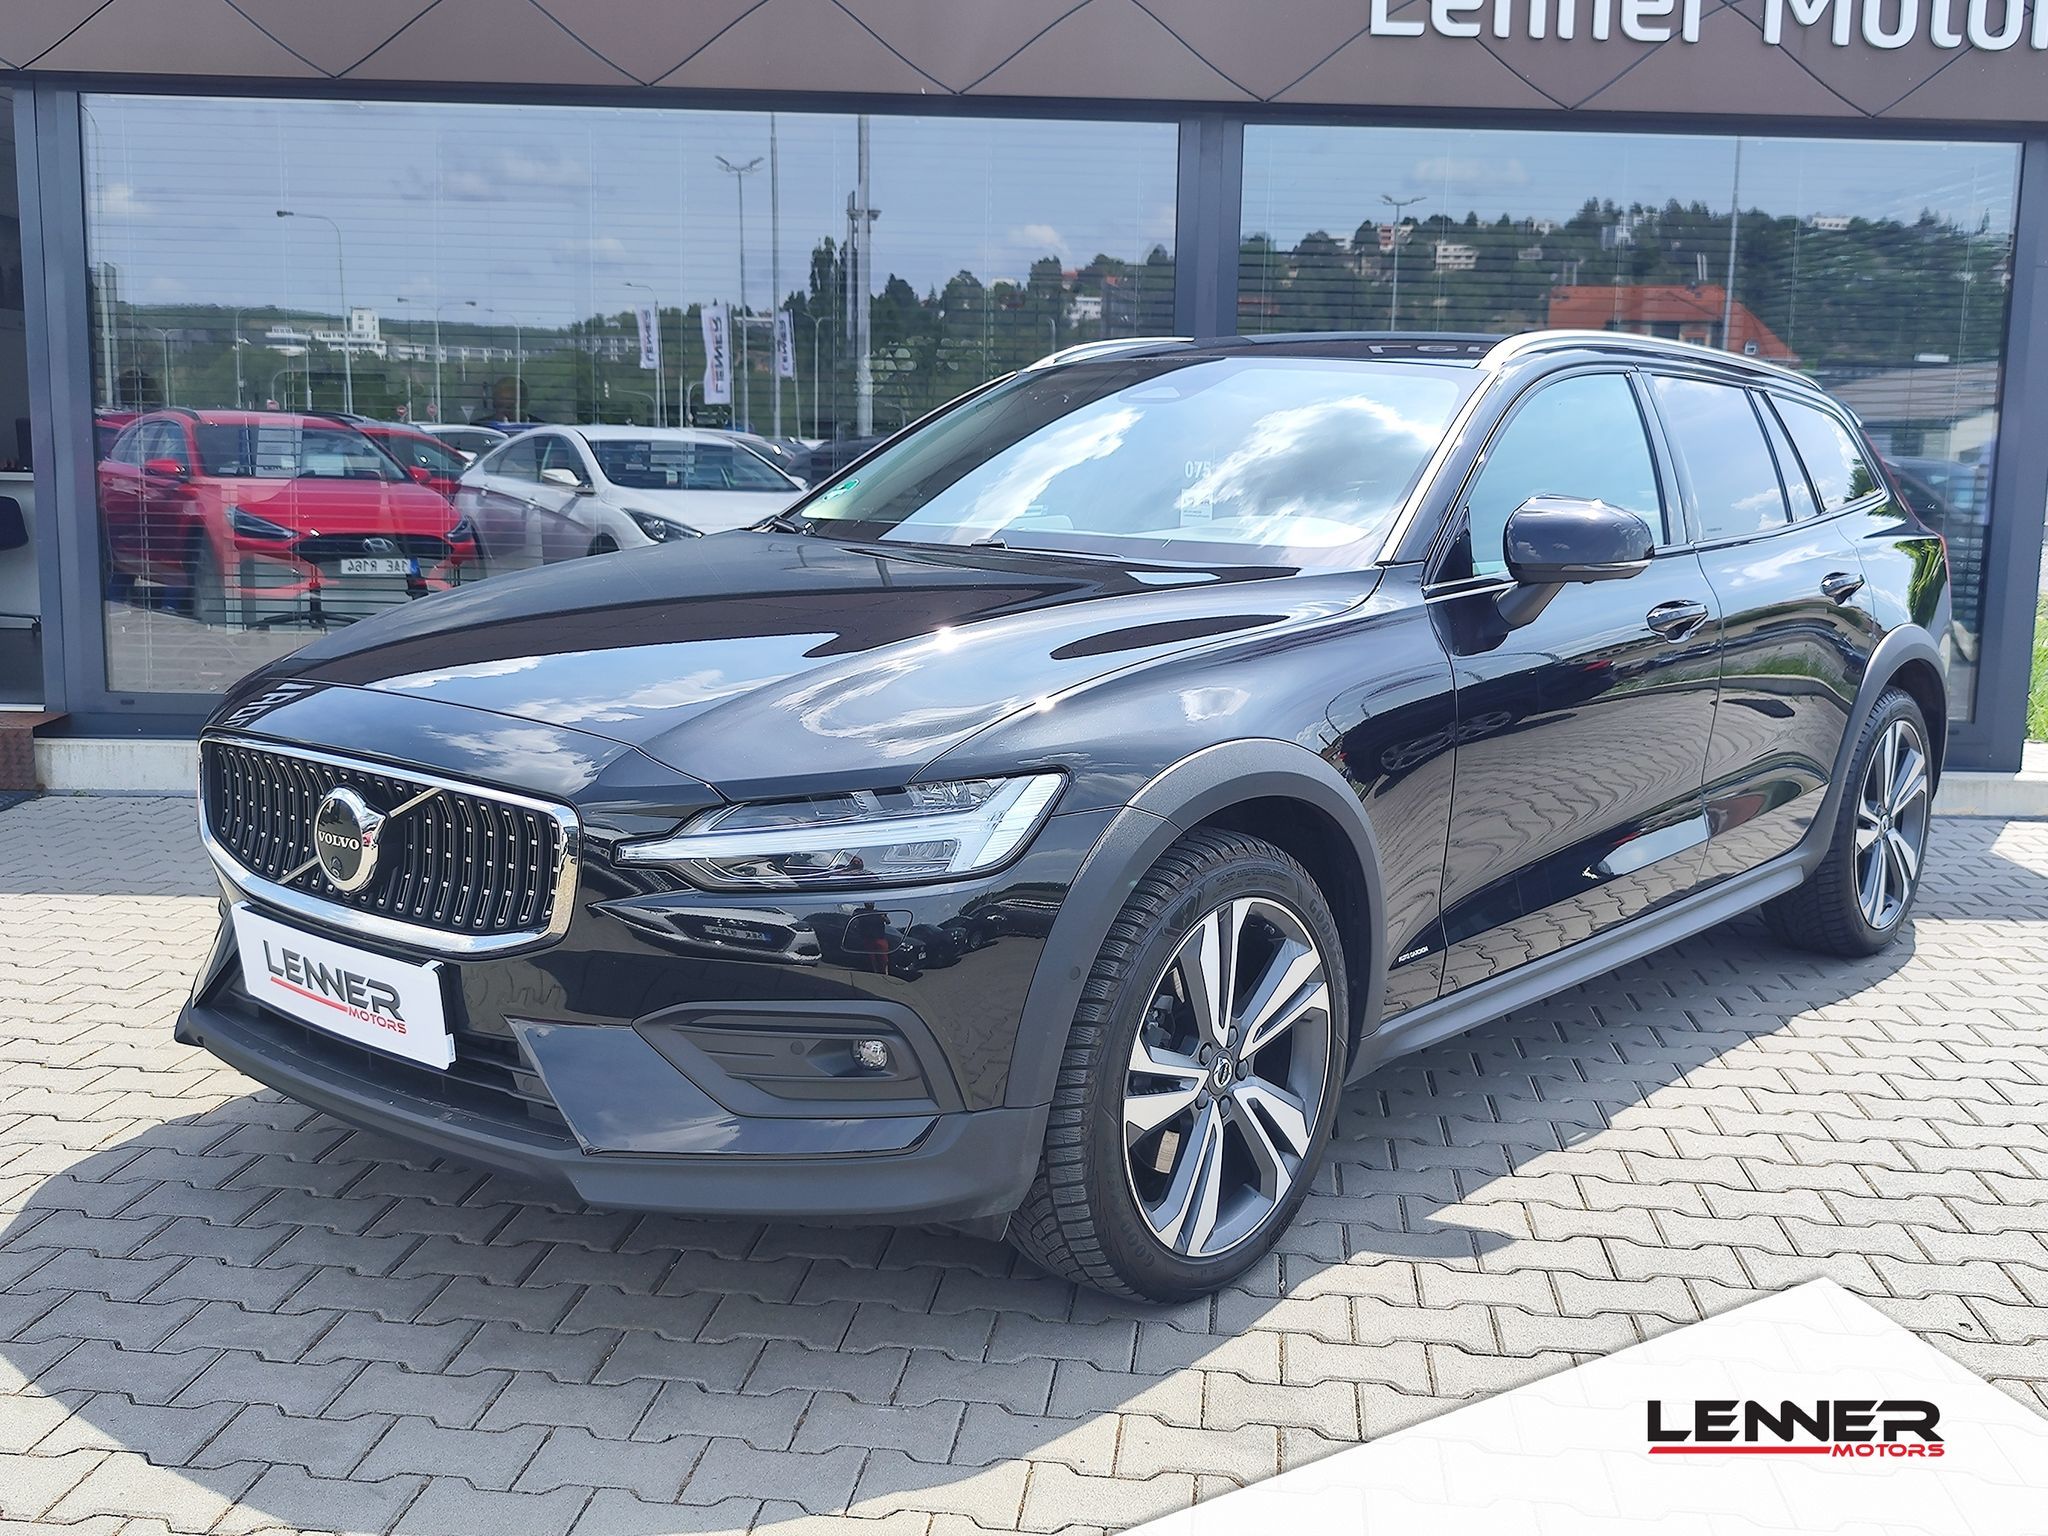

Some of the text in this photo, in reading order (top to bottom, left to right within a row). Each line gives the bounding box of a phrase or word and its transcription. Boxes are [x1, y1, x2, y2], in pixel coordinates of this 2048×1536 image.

[318, 830, 360, 851] VOLVO
[263, 939, 405, 1022] LENNER
[348, 1006, 408, 1035] MOTORS
